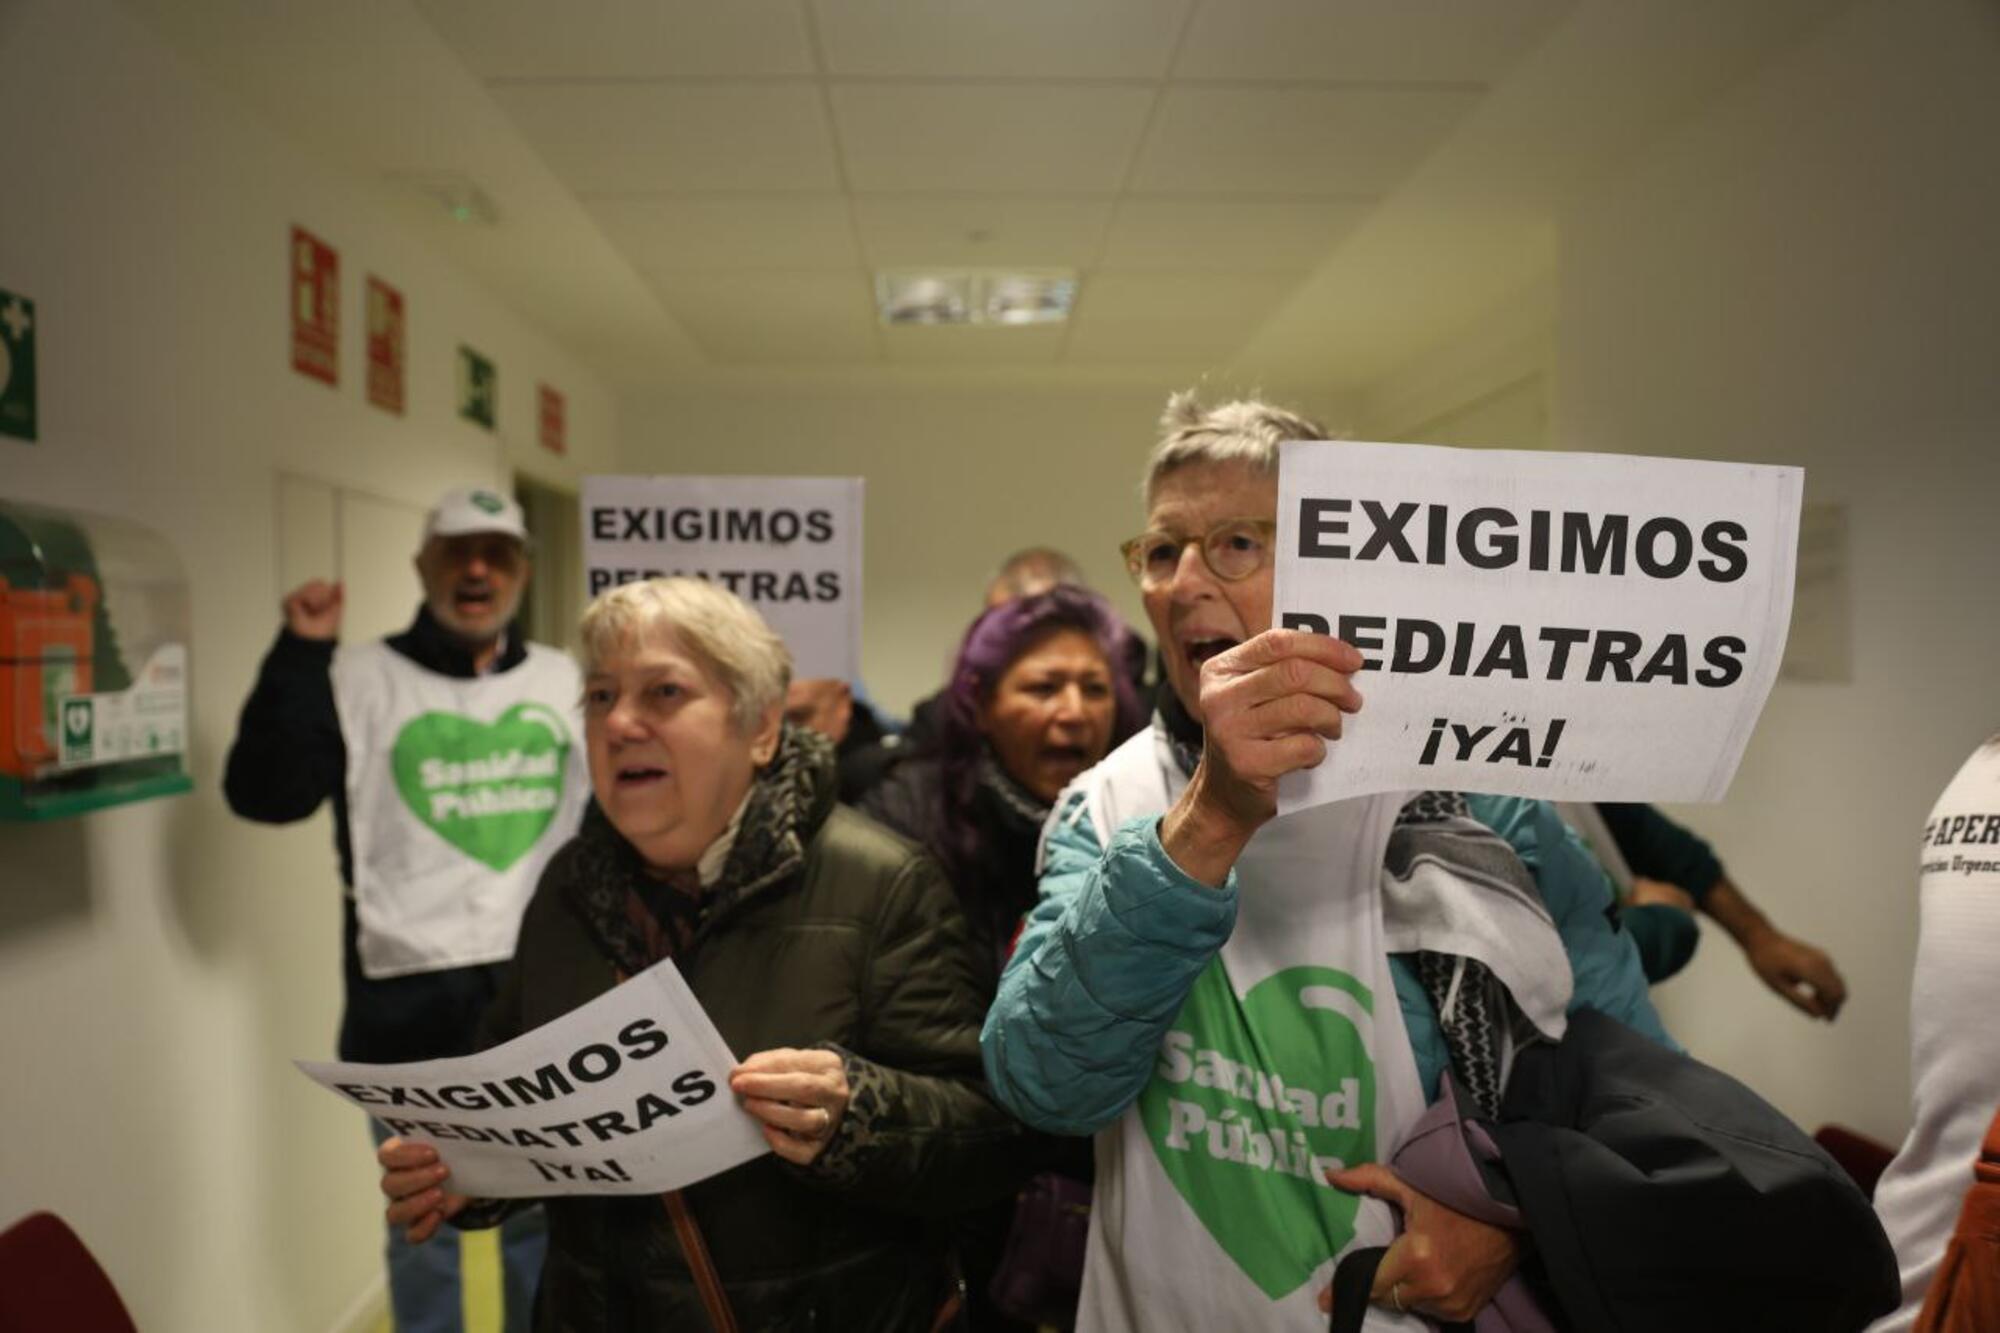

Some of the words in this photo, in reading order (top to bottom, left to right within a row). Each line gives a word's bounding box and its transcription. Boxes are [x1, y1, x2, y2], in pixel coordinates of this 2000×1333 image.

[591, 508, 833, 543] EXIGIMOS
[1298, 498, 1748, 582] EXIGIMOS
[589, 569, 841, 601] PTRAS
[1418, 718, 1566, 769] ¡YA!
[334, 1018, 668, 1111] EXIGIMOS
[385, 1069, 716, 1149] PEDIATRAS
[528, 1158, 632, 1183] ¡YA!
